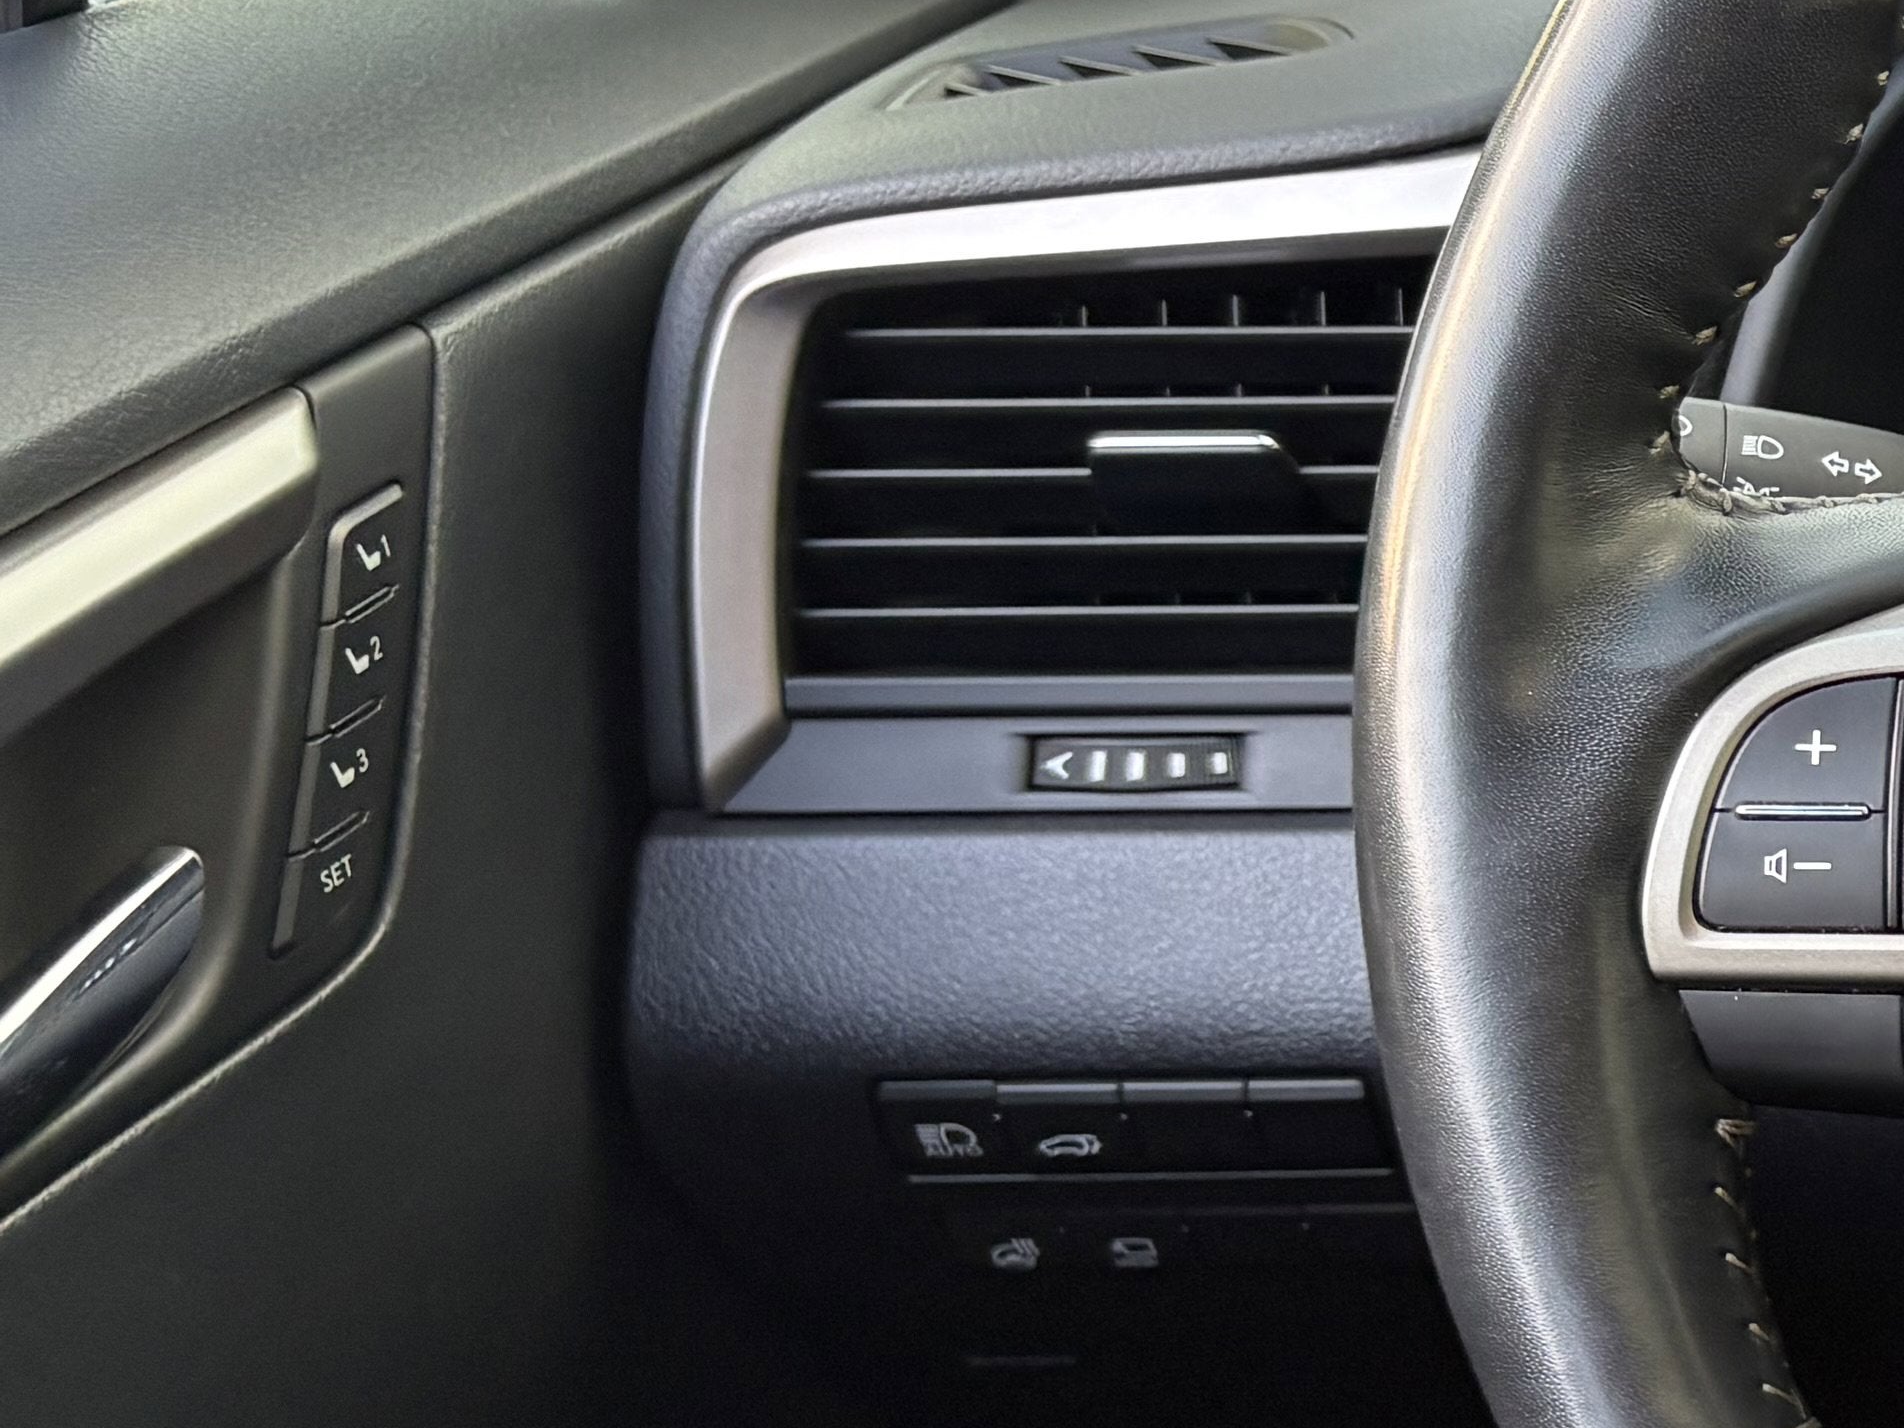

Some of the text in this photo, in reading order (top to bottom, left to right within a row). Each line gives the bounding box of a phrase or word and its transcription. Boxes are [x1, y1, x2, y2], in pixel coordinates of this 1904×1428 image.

[379, 534, 391, 559] 1
[369, 635, 384, 661] 2
[355, 746, 370, 774] 3
[319, 853, 354, 894] SET
